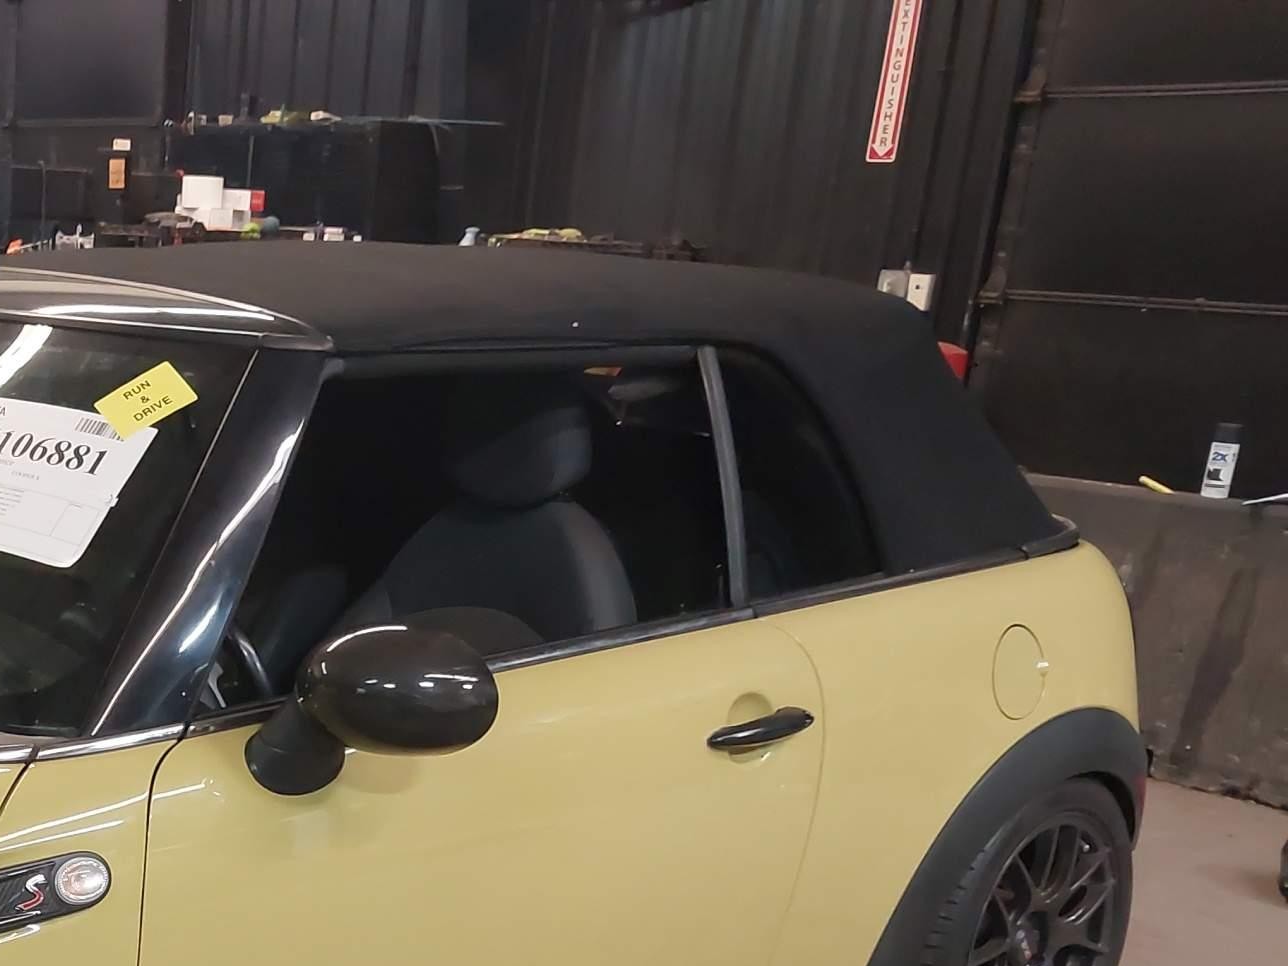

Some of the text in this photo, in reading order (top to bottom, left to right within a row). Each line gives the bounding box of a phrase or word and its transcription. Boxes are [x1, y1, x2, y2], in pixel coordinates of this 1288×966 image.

[879, 0, 911, 147] EXTINGUISHER
[123, 380, 151, 400] RUN
[141, 395, 150, 404] &
[133, 396, 173, 422] DRIVE
